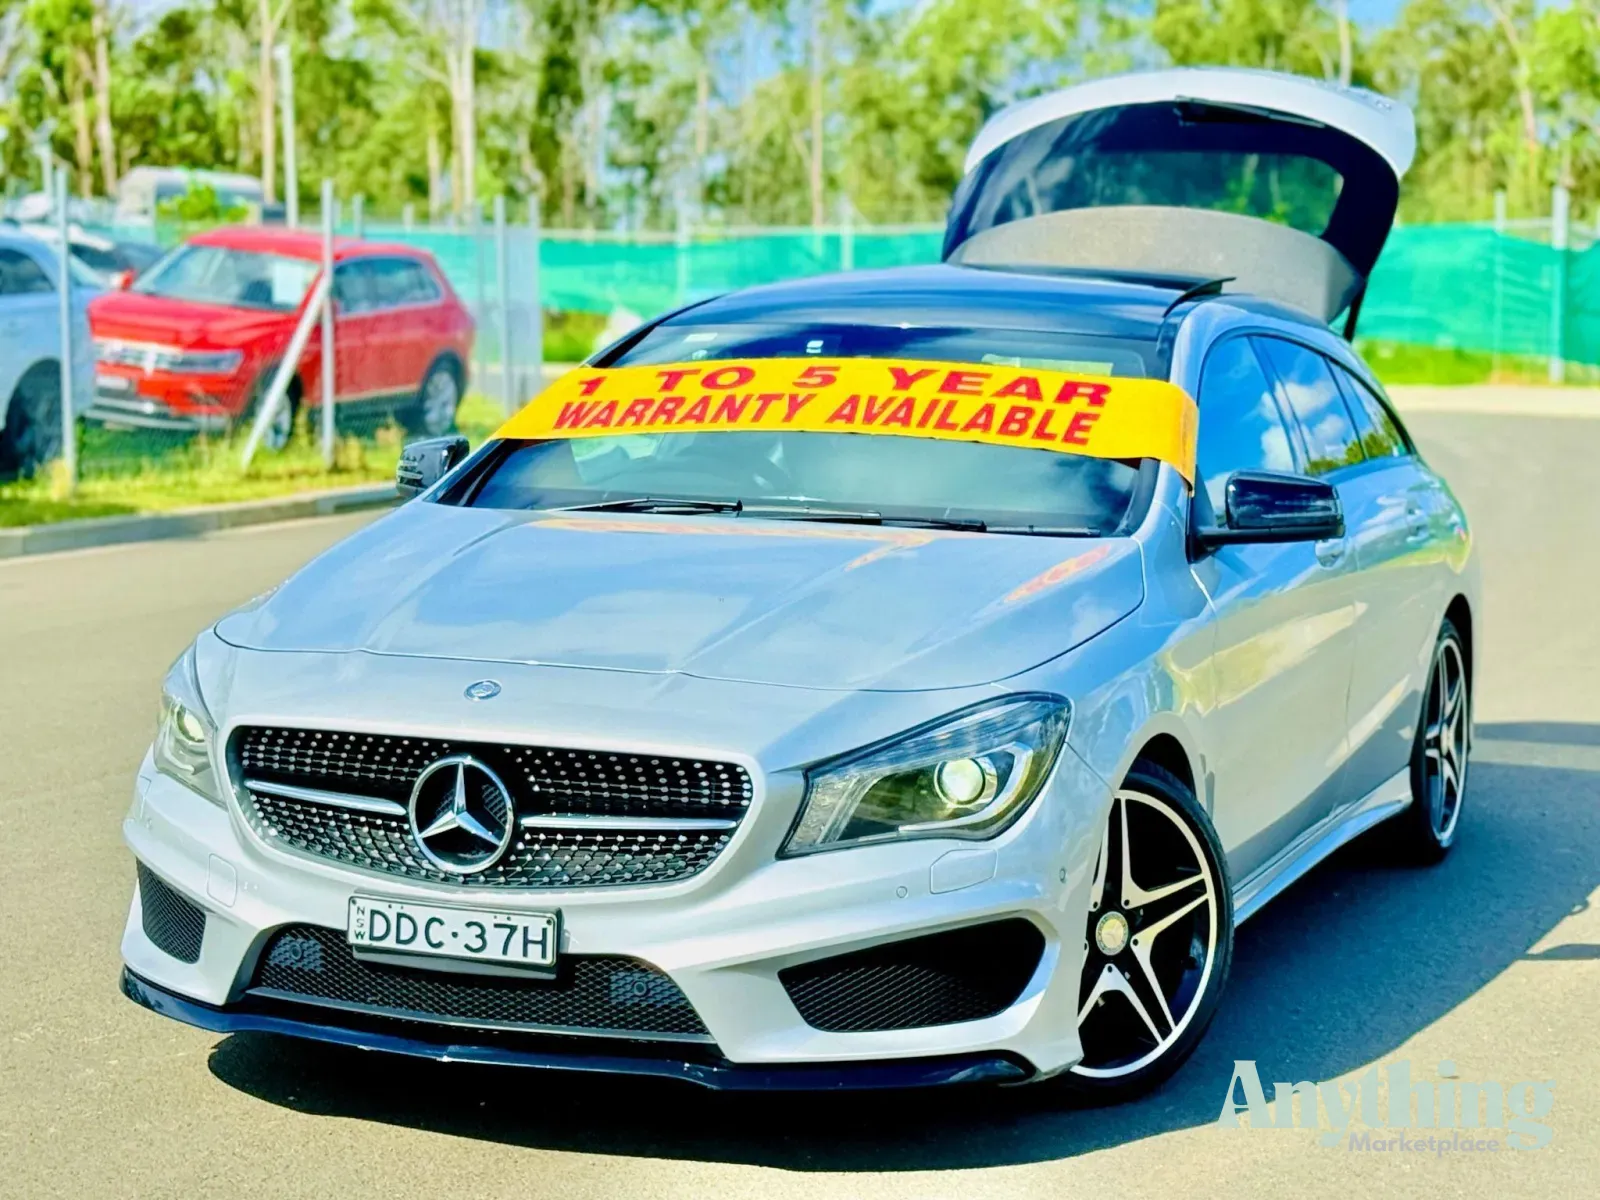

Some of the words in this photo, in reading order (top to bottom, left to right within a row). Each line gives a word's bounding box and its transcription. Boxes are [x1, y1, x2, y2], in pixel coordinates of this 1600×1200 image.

[578, 376, 608, 397] 1
[655, 366, 756, 393] TO
[792, 366, 841, 389] 5
[888, 366, 1112, 408] YEAR
[552, 393, 819, 430] WARRANTY
[824, 394, 1101, 446] AVAILABLE
[354, 906, 366, 940] NSW
